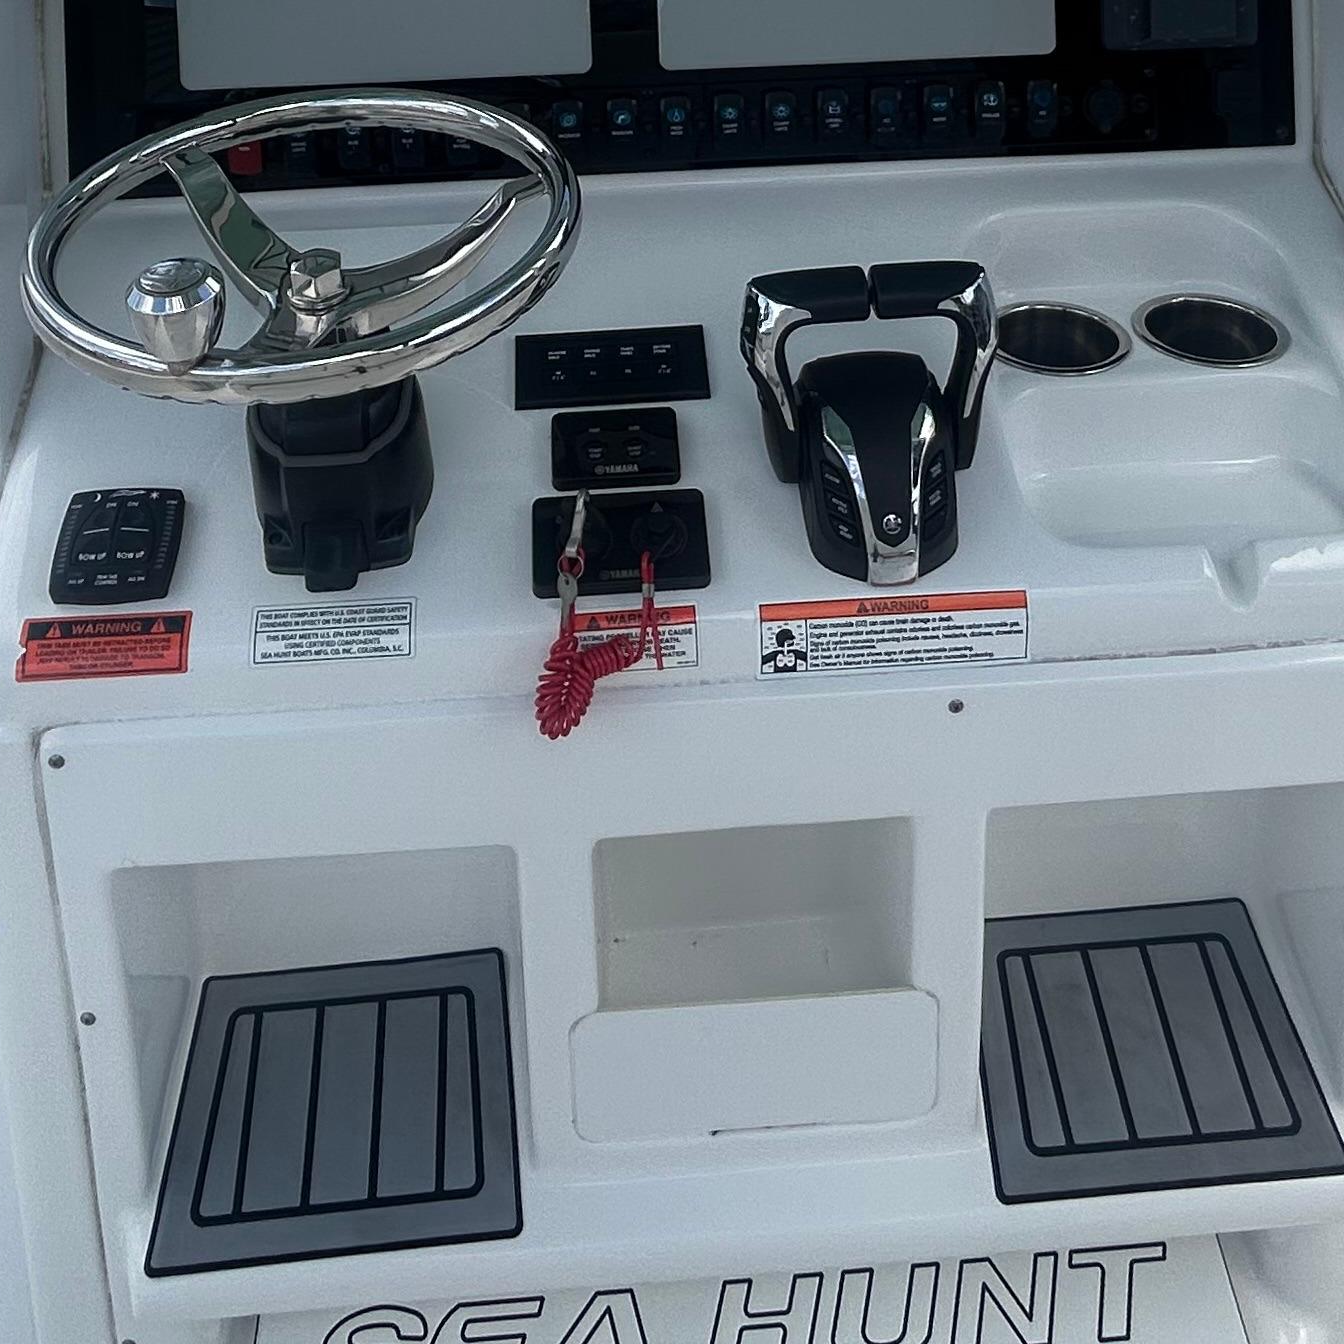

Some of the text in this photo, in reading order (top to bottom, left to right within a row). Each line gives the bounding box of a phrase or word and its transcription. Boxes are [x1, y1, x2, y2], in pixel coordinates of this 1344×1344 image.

[609, 568, 641, 578] YAMAH
[871, 599, 929, 613] WARNING
[606, 611, 671, 625] WARNG
[71, 621, 142, 635] WARNING
[667, 628, 693, 636] CAUSE
[708, 1242, 1167, 1344] HUNT
